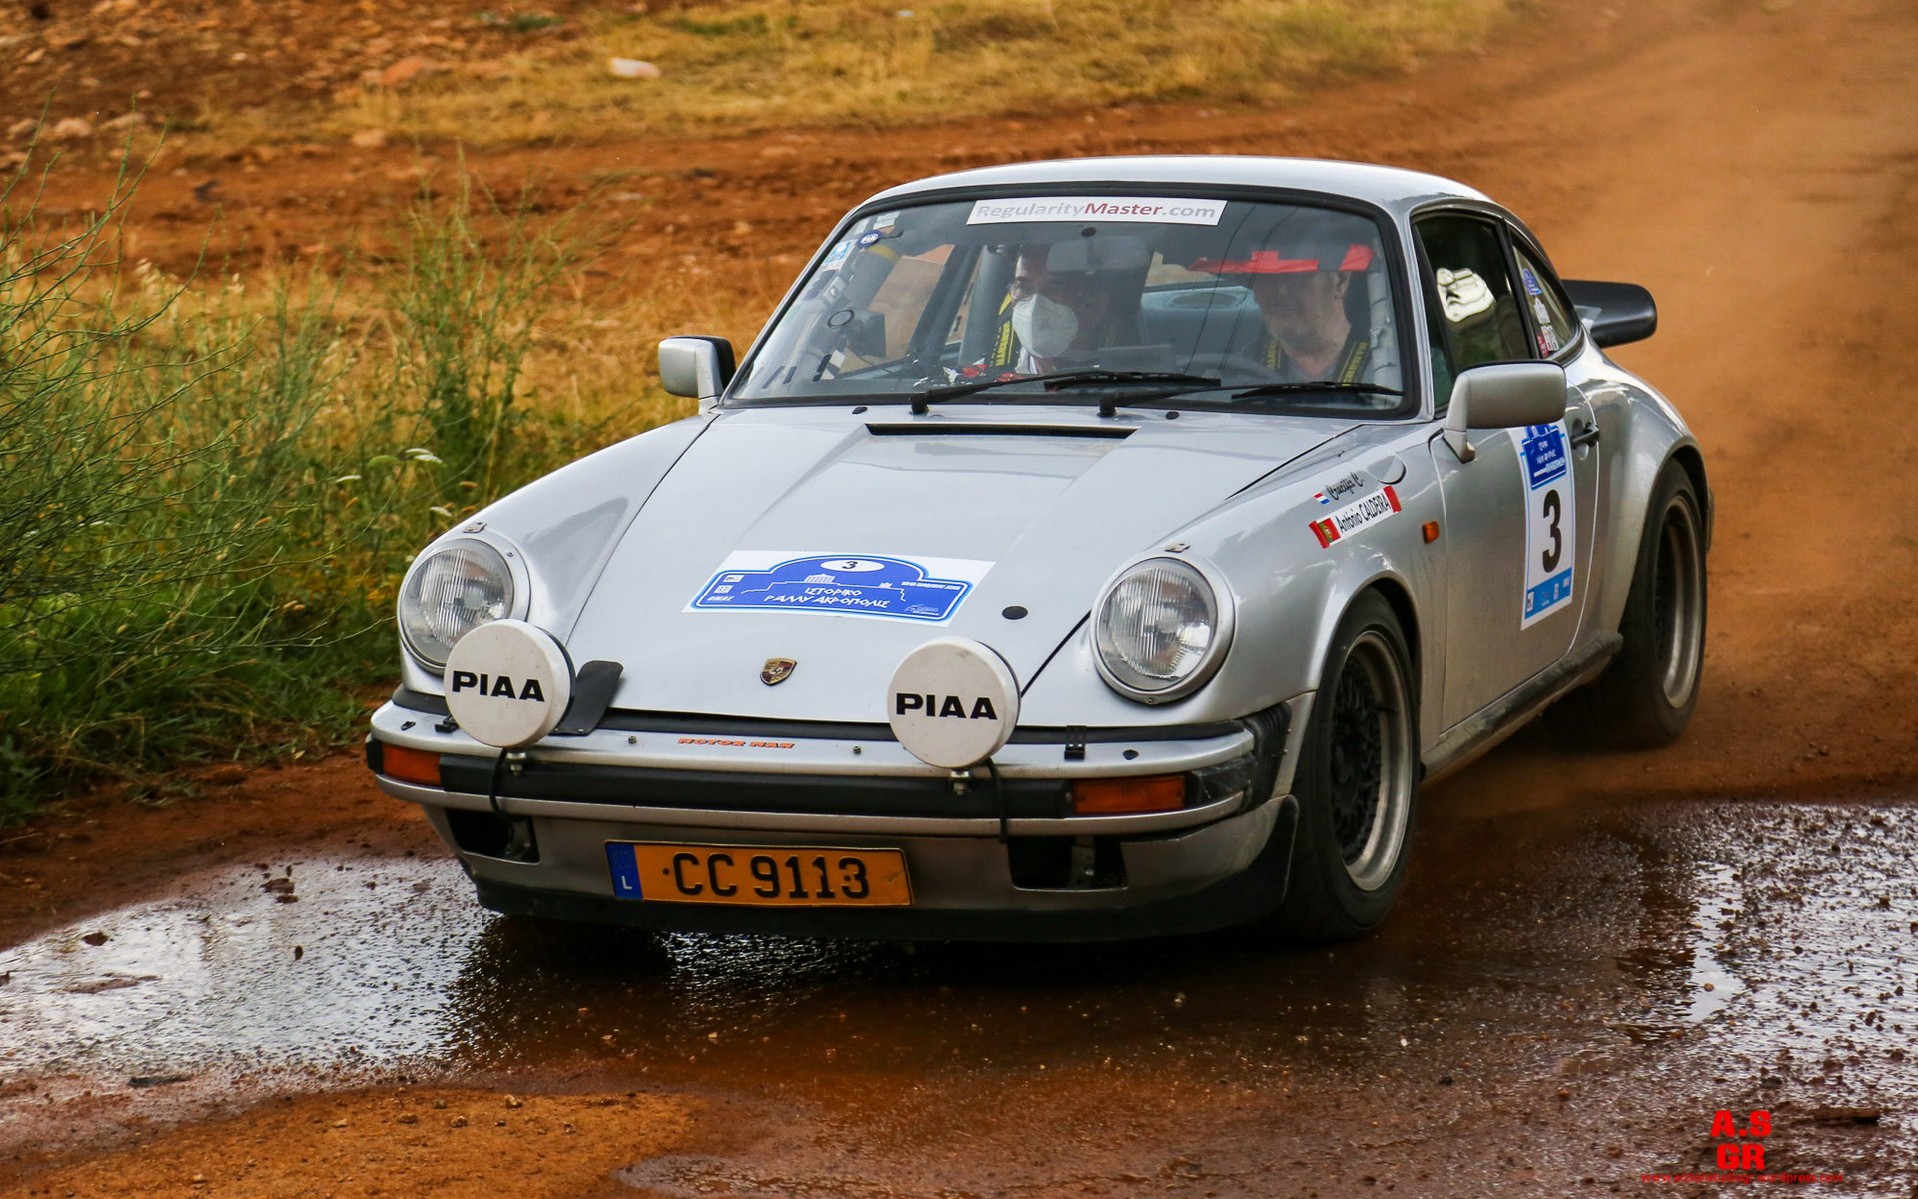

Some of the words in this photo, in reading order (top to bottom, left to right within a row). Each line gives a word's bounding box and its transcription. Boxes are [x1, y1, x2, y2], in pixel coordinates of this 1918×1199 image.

[976, 202, 1216, 218] RegularityMaster.com
[1335, 508, 1363, 534] António
[1359, 493, 1392, 521] CALDEIRA
[1542, 489, 1562, 573] 3
[842, 561, 858, 570] 3
[452, 670, 545, 702] PIAA
[896, 692, 998, 720] PIAA
[677, 738, 746, 747] MOTOR
[749, 741, 795, 749] MAN
[621, 875, 632, 890] L
[672, 852, 738, 896] CC
[750, 854, 869, 899] 9113
